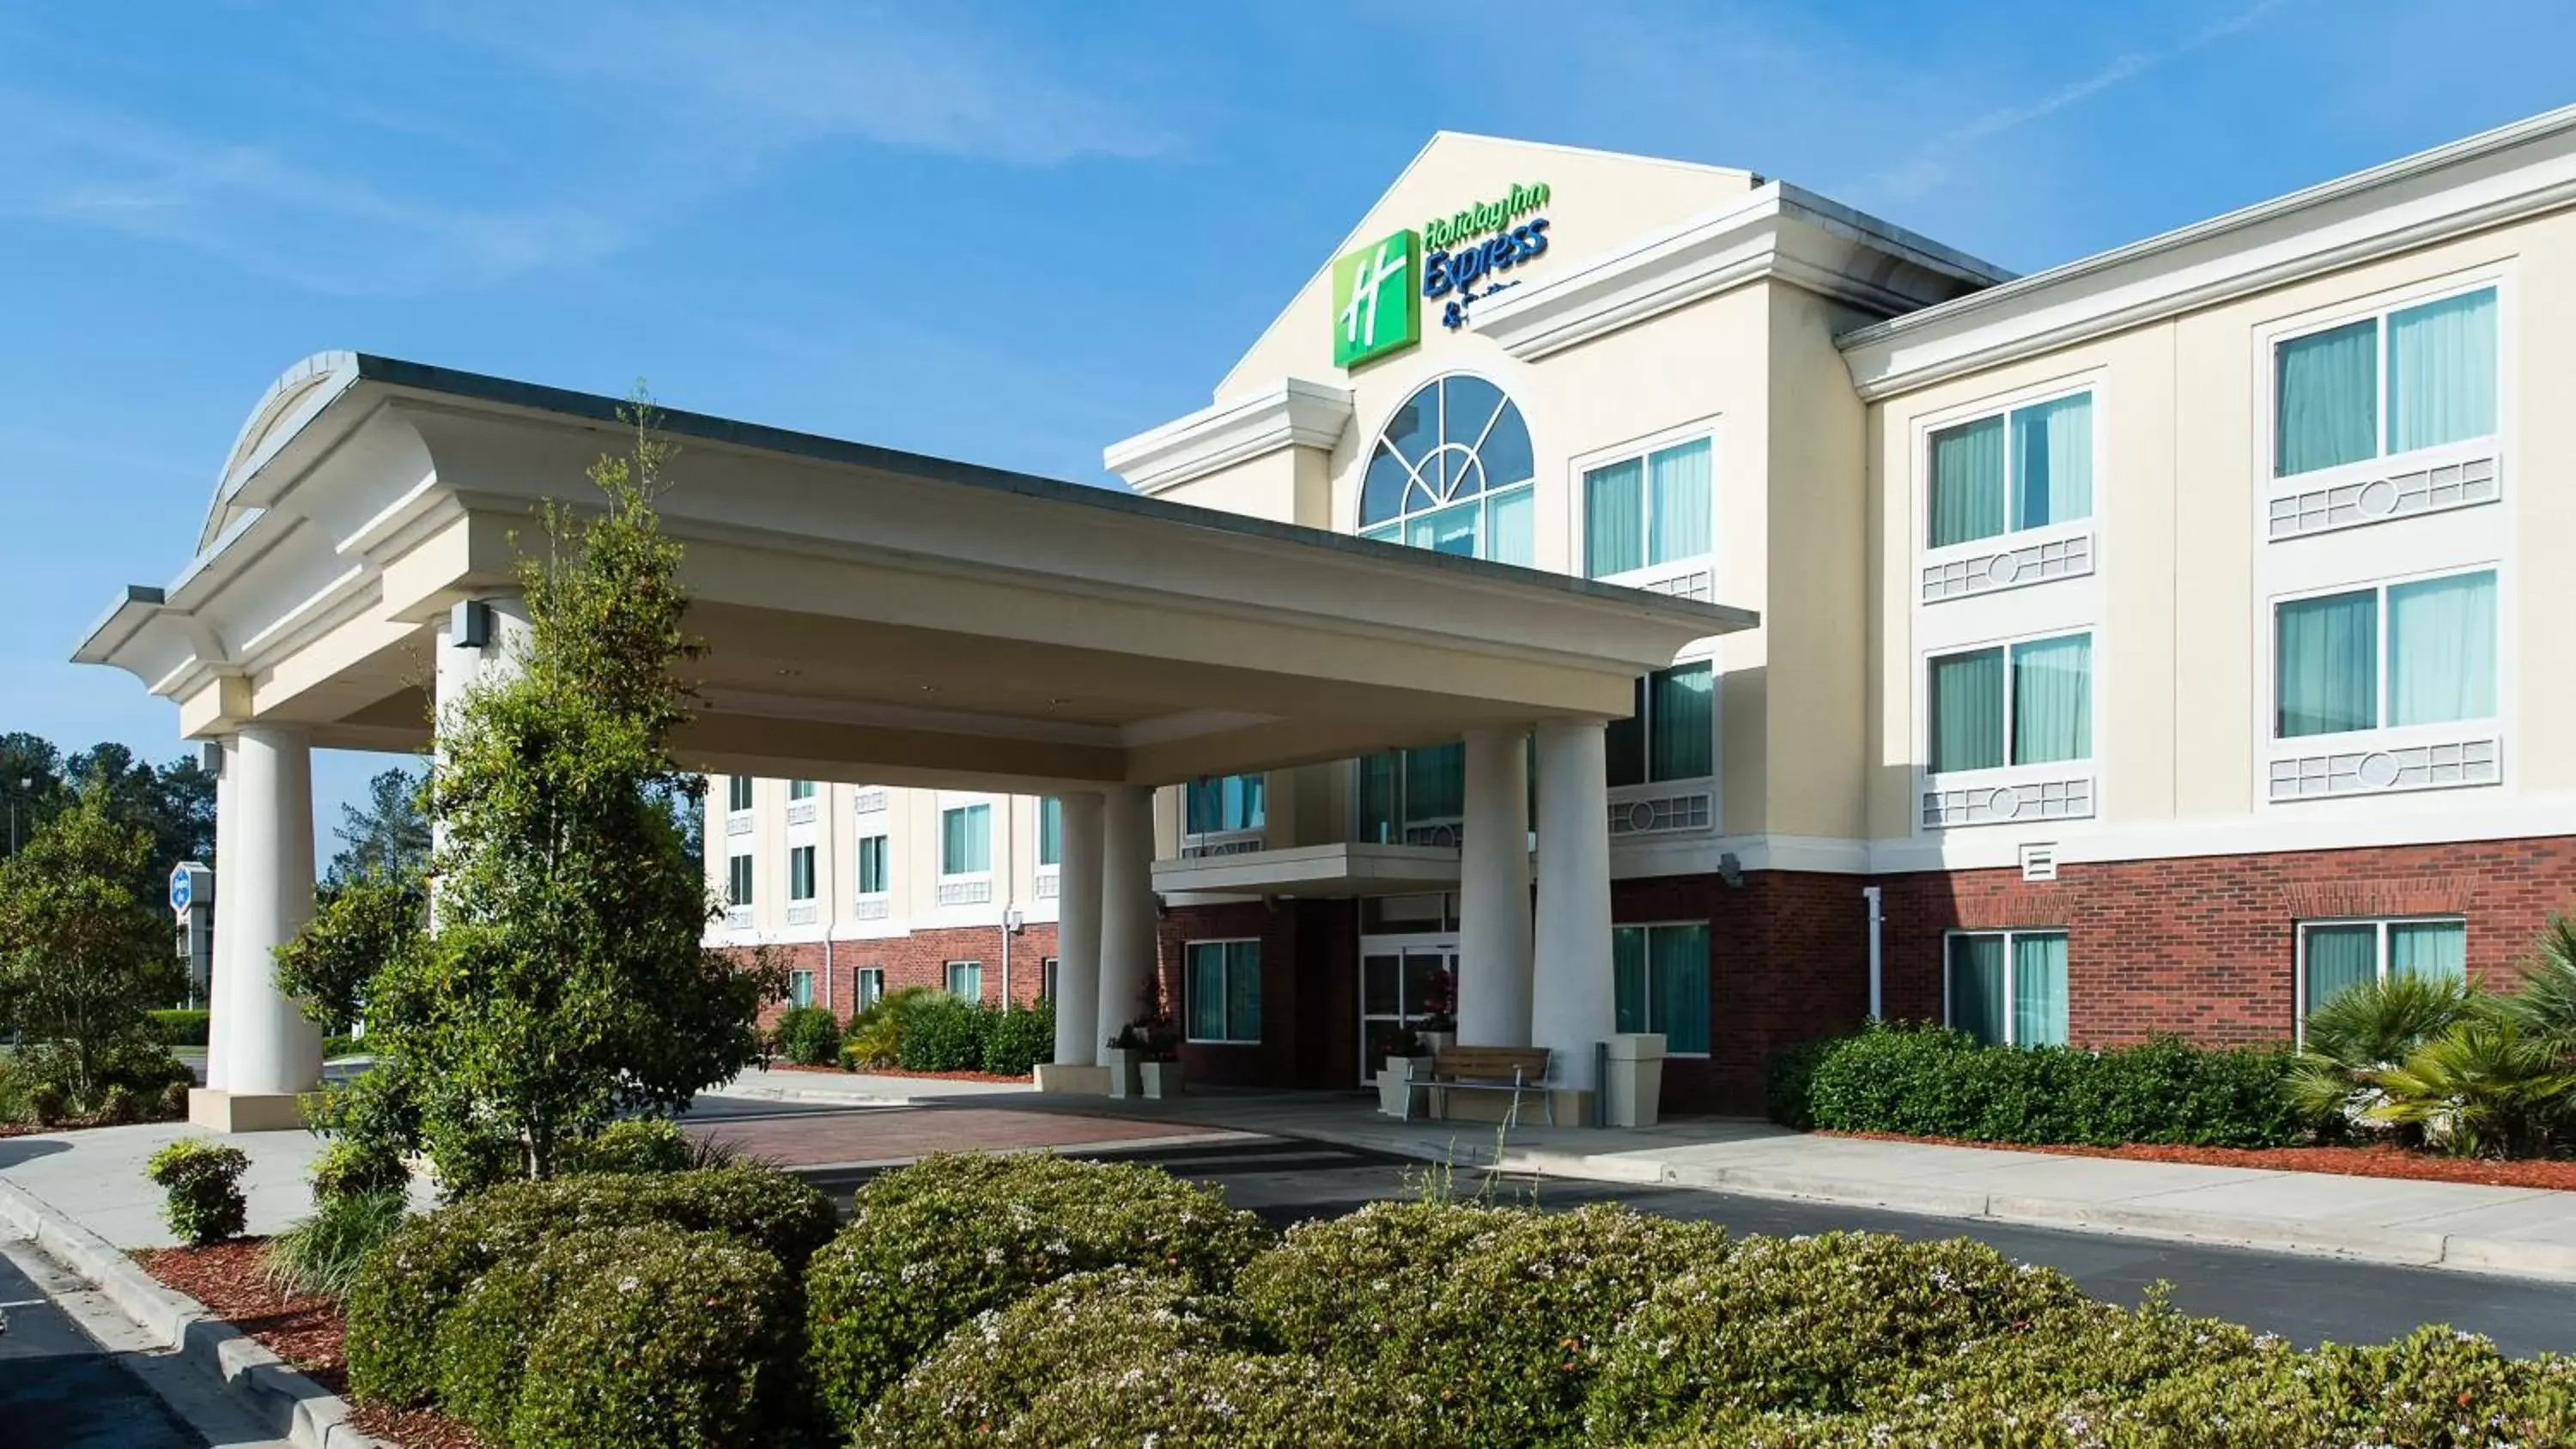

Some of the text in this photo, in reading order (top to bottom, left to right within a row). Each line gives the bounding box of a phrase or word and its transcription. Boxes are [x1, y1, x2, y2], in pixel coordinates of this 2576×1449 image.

[1424, 183, 1550, 251] Holiday Inn
[1423, 218, 1550, 298] Express
[1443, 301, 1462, 330] &
